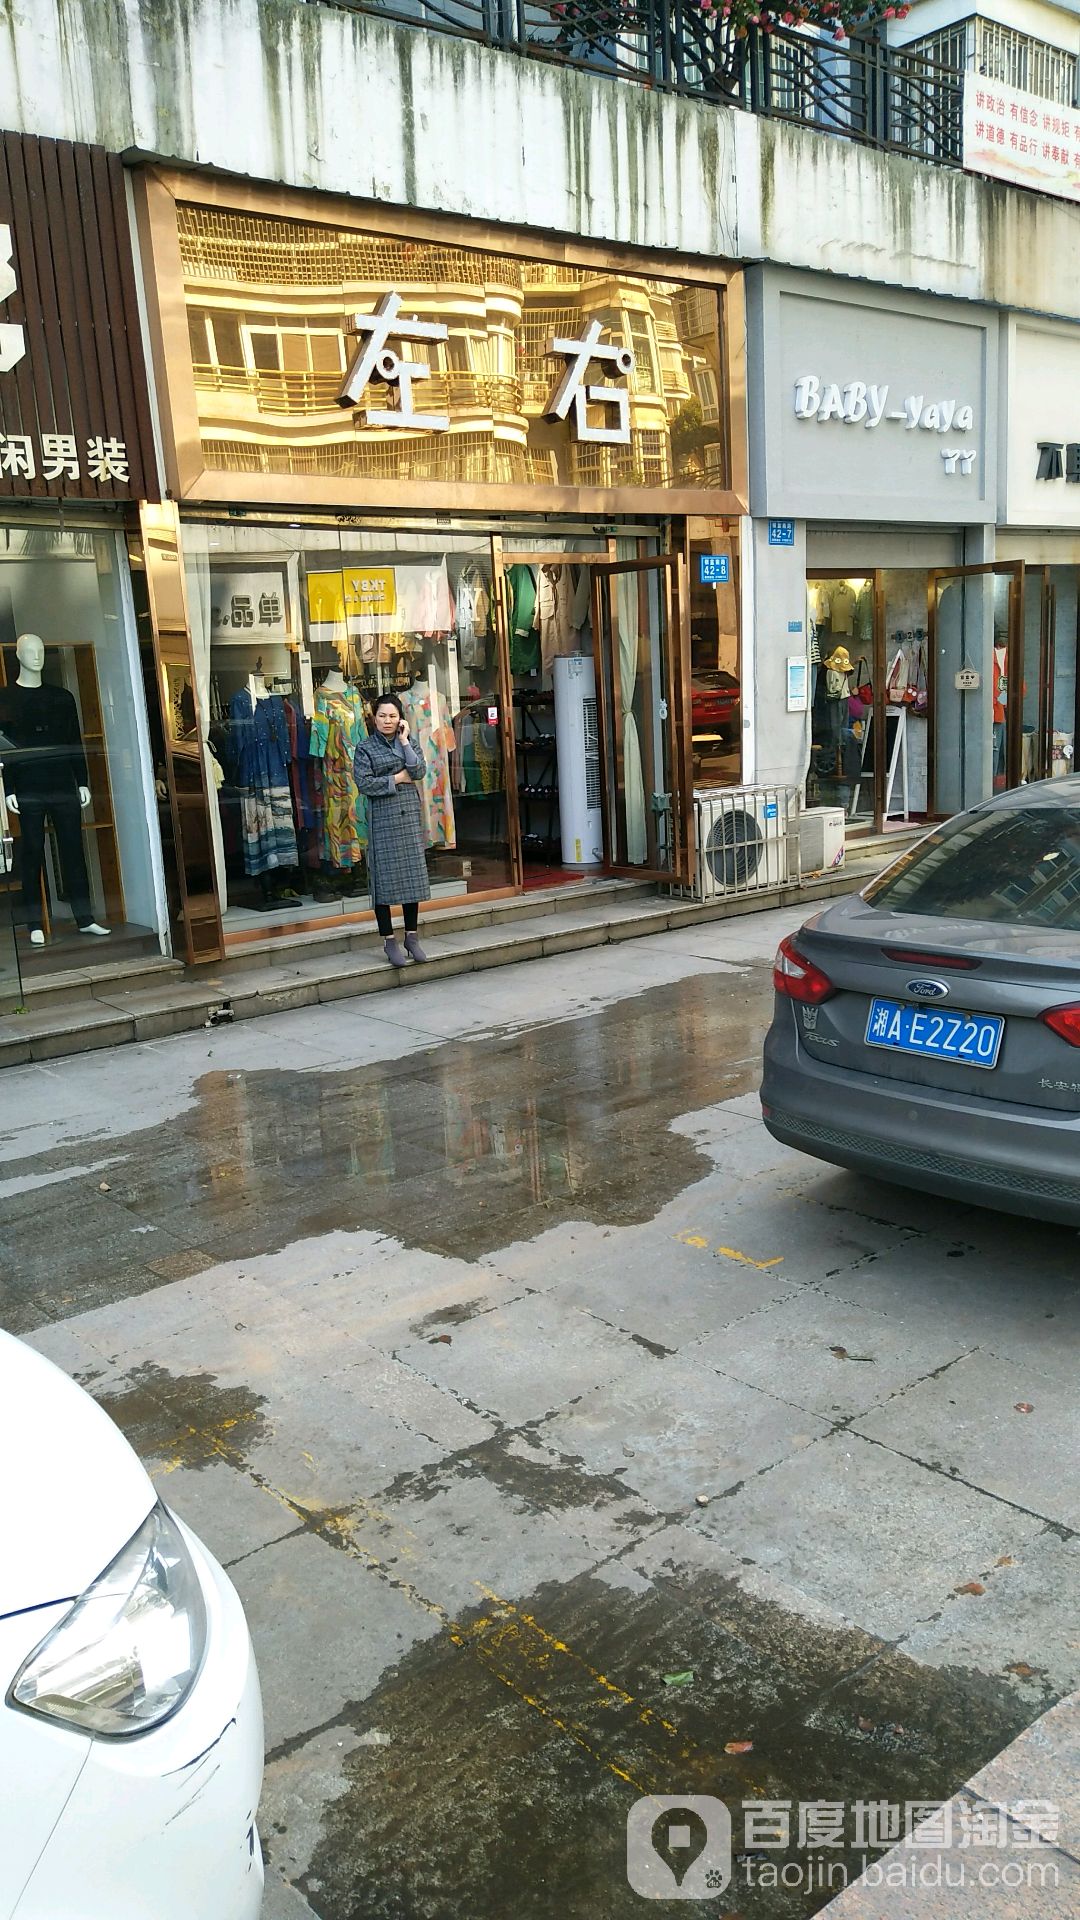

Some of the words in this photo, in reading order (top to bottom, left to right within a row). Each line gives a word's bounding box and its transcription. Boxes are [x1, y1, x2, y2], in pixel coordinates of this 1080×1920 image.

[976, 90, 1005, 117] 讲政治
[1010, 103, 1038, 127] 有信念
[1043, 113, 1070, 138] 讲规矩
[975, 120, 1005, 145] 讲道德
[1010, 132, 1038, 157] 有品行
[1042, 142, 1069, 165] 讲奉献
[335, 290, 636, 446] 左右
[772, 529, 792, 539] 42-7
[704, 565, 726, 575] 42-8
[913, 982, 937, 996] Ford
